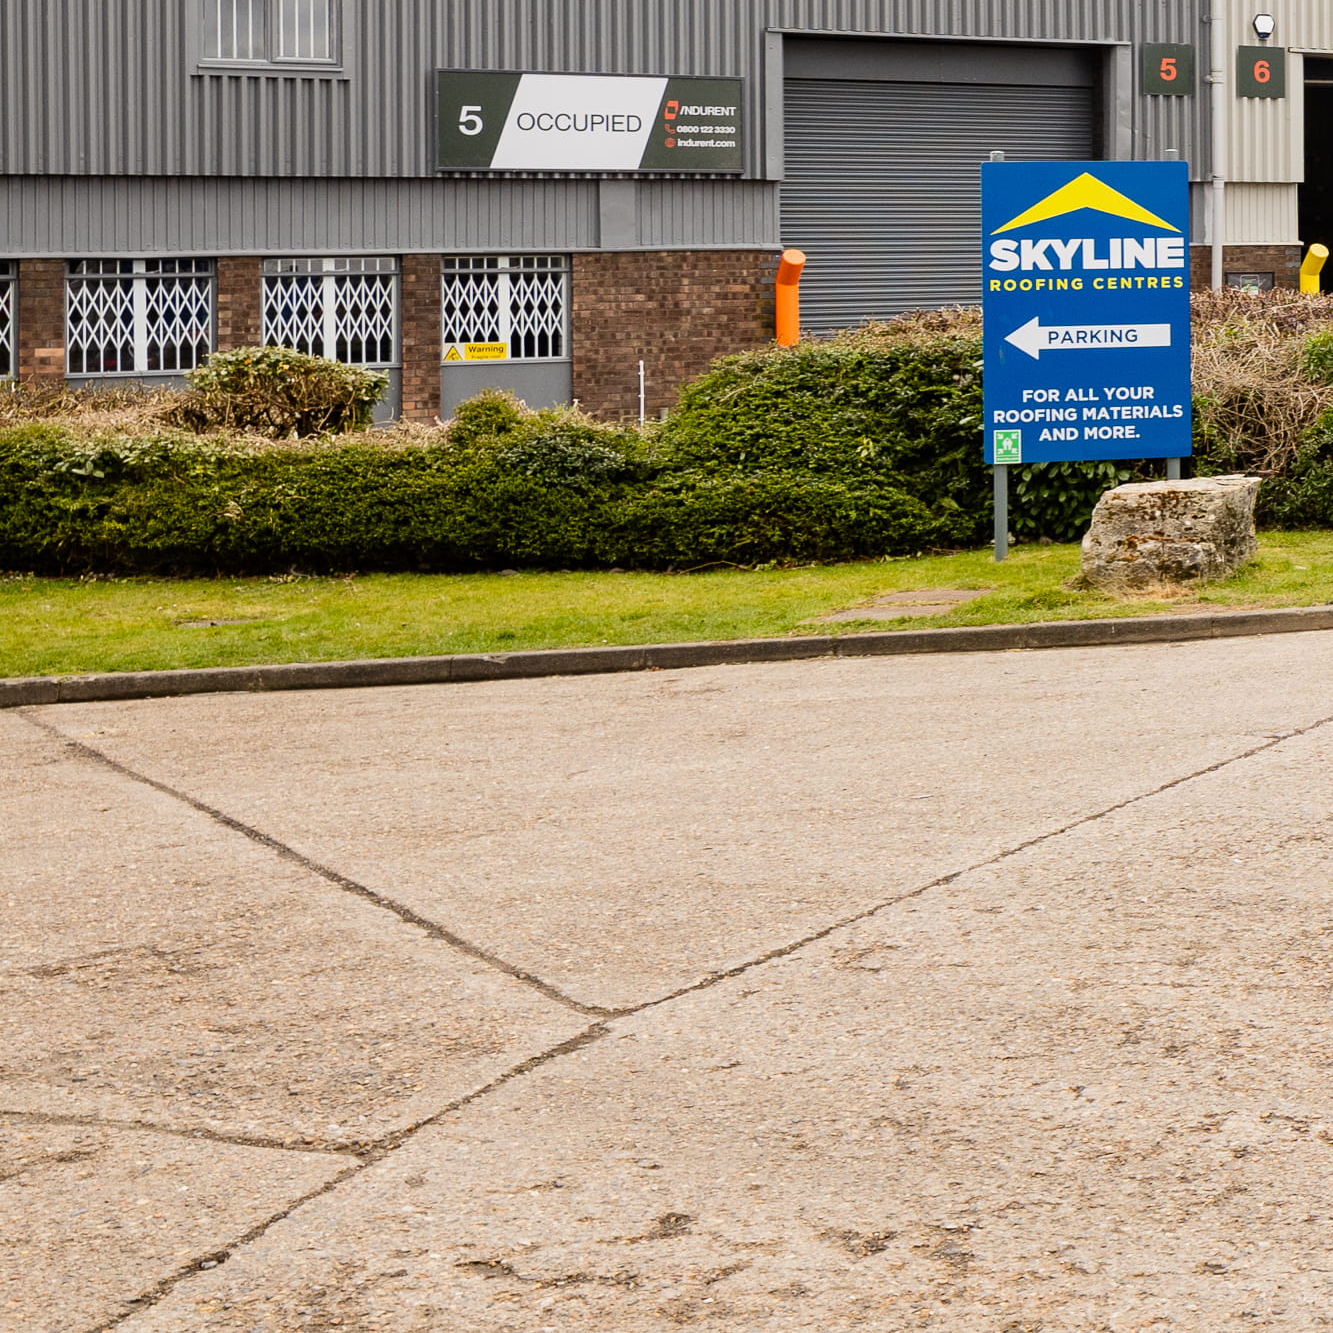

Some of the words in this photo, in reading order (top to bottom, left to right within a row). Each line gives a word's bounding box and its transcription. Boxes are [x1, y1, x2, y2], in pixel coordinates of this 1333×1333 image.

[1159, 58, 1177, 81] 5
[1253, 60, 1271, 83] 6
[458, 105, 483, 136] 5
[516, 112, 642, 132] OCCUPIED
[677, 138, 735, 147] indurent.com
[989, 237, 1185, 272] SKYLINE
[989, 278, 1084, 291] ROOFING
[1093, 276, 1184, 290] CENTRES
[1048, 329, 1139, 345] PARKING
[1023, 389, 1060, 403] FOR
[1065, 388, 1099, 402] ALL
[1103, 386, 1154, 401] YOUR
[993, 408, 1077, 423] ROOFING
[1083, 405, 1183, 421] MATERIALS
[1039, 428, 1079, 442] AND
[1084, 425, 1141, 440] MORE.
